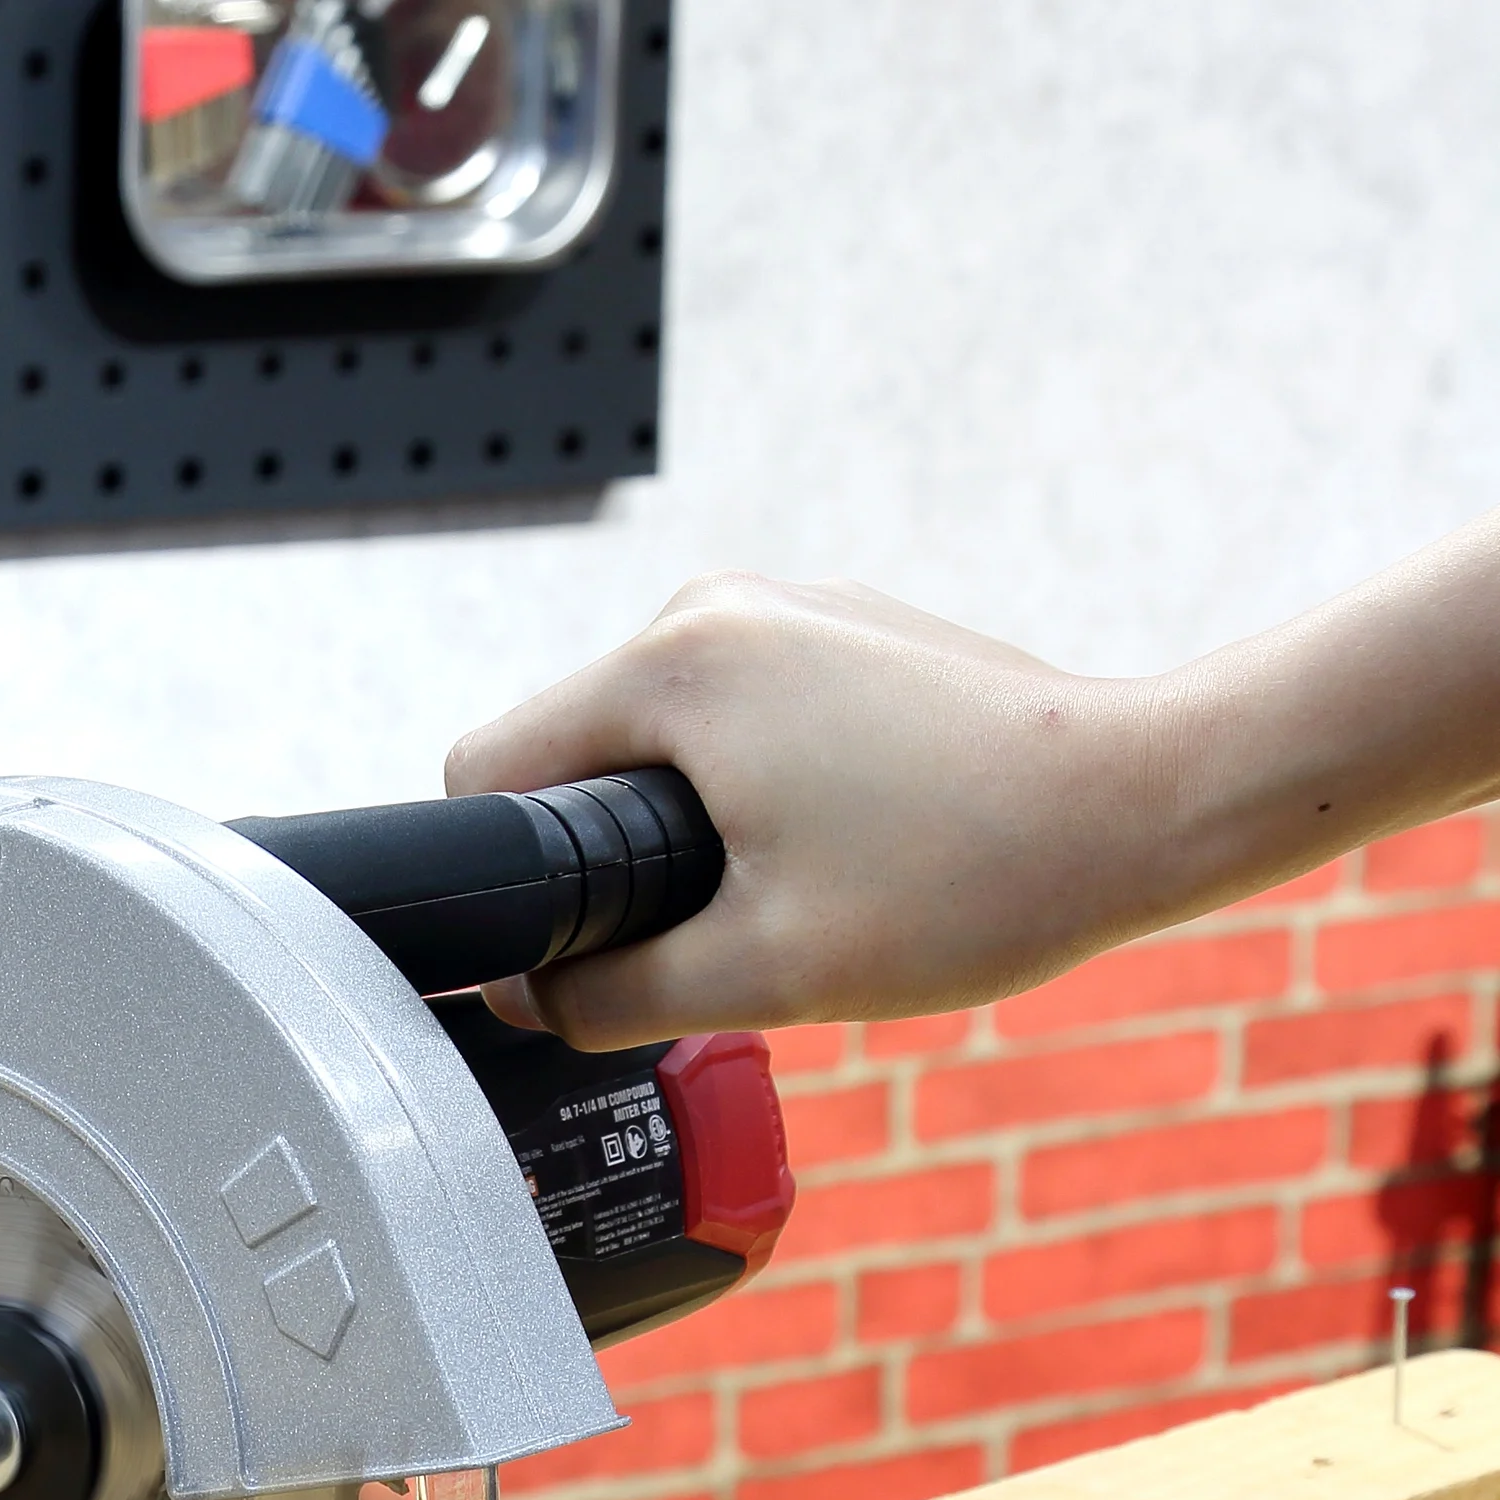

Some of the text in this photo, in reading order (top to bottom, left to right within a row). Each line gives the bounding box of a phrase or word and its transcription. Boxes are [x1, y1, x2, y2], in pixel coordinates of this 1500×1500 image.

[559, 1106, 573, 1121] 9A
[572, 1098, 597, 1116] 7-1/4
[608, 1081, 655, 1107] COMPOUND
[613, 1097, 661, 1123] MITER SAW
